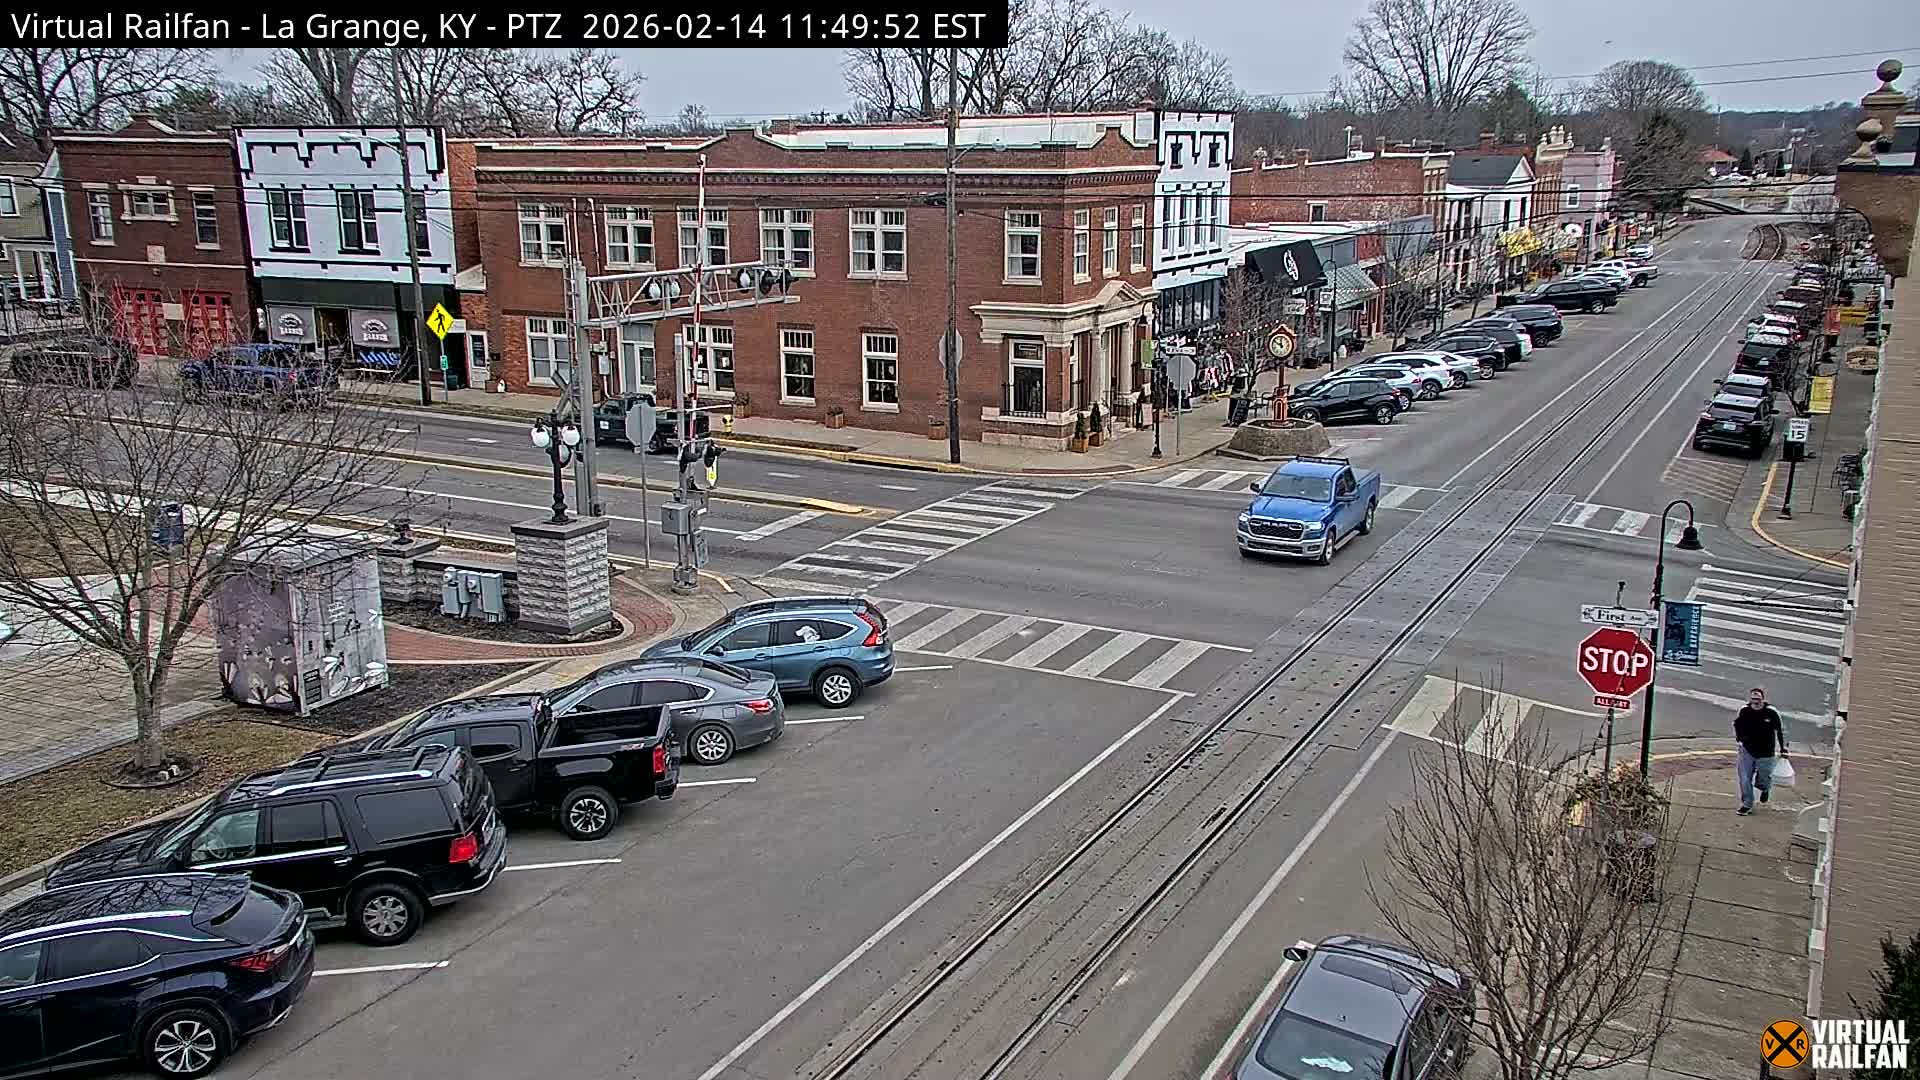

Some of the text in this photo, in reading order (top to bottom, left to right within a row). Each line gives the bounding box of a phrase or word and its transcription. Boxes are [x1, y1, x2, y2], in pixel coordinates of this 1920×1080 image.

[1792, 430, 1805, 440] 15
[1597, 609, 1625, 621] First
[1583, 646, 1648, 676] STOP
[1596, 697, 1610, 706] ALL
